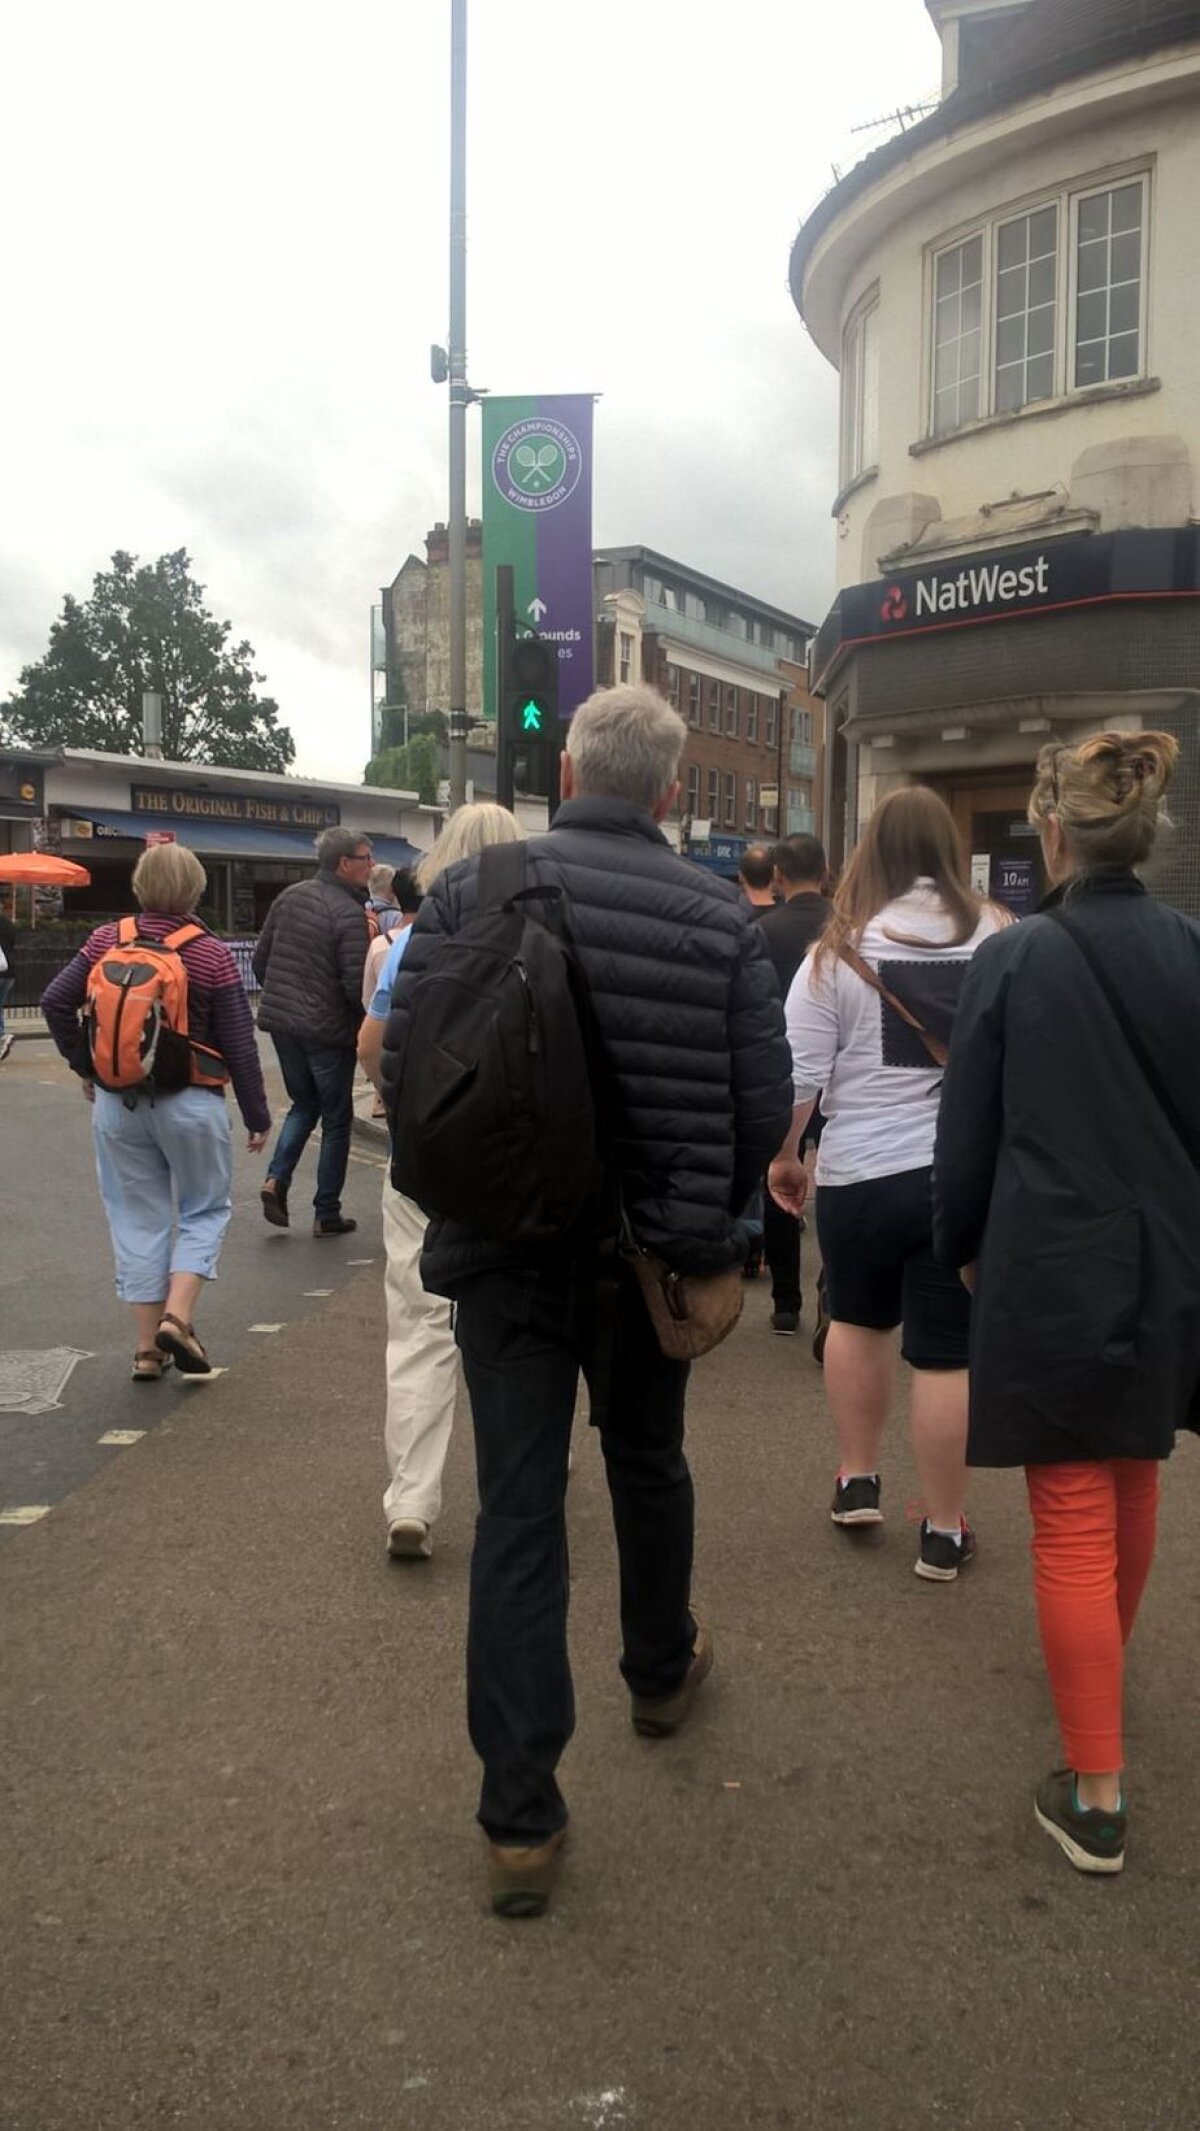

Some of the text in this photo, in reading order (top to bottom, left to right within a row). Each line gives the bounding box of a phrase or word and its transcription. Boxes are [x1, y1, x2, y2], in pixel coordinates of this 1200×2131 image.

[497, 423, 577, 463] THE CHAMPIONSHIPS
[508, 486, 566, 507] WIMBLEDON
[916, 556, 1049, 616] NatWest
[137, 792, 168, 810] THE
[172, 792, 242, 817] ORIGINAL
[246, 799, 277, 820] FISH
[280, 805, 289, 822] &
[292, 804, 322, 824] CHIP
